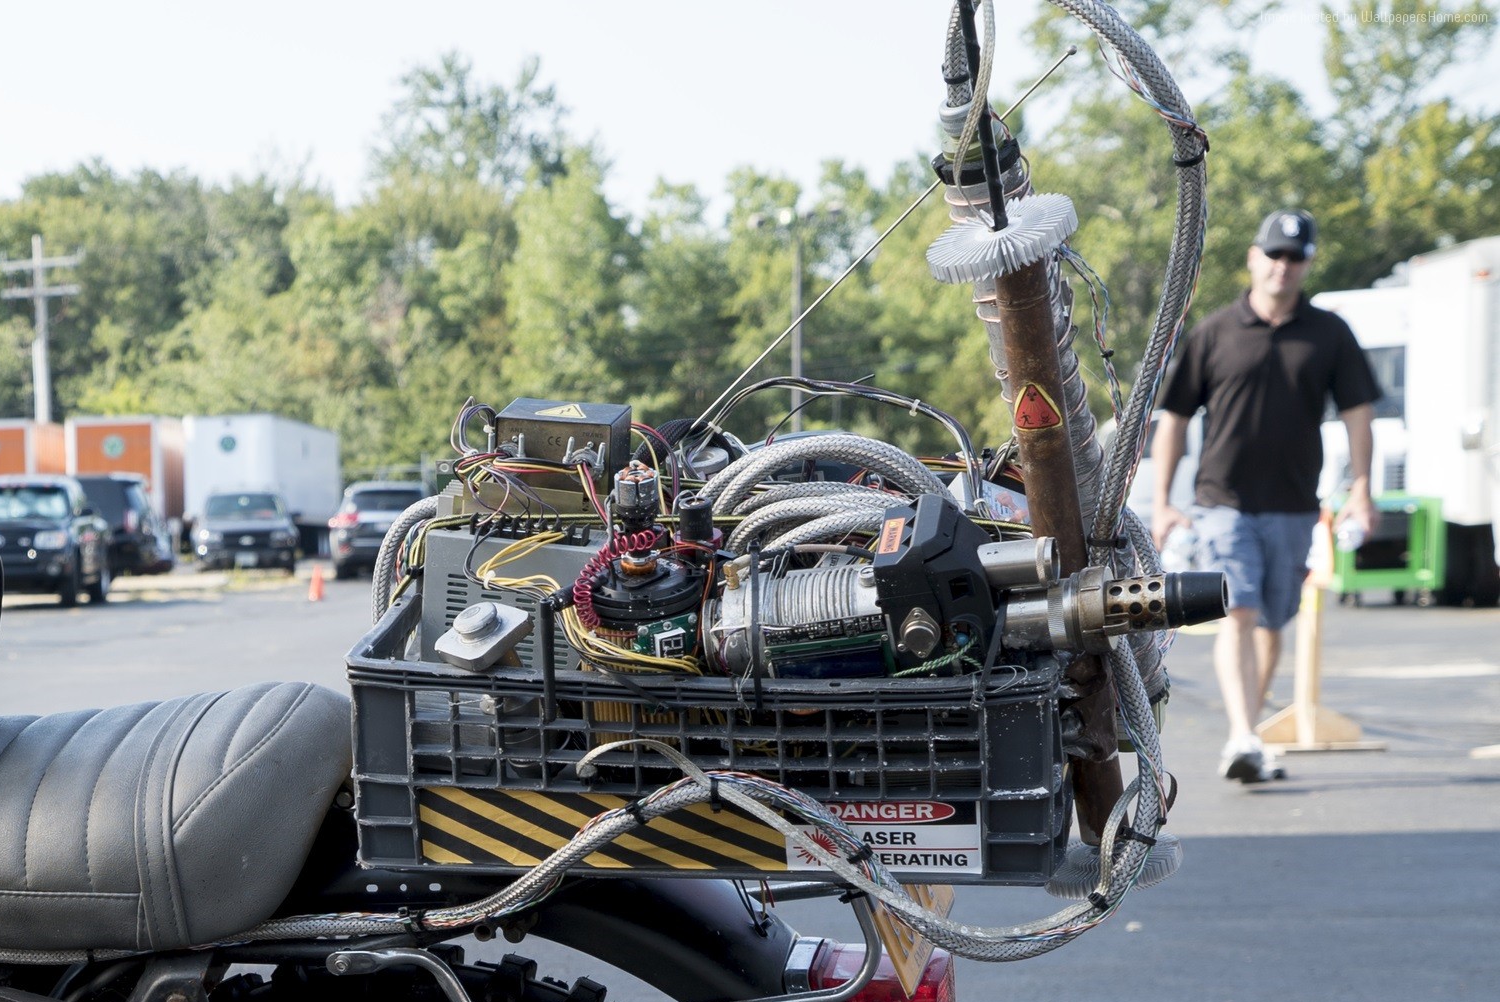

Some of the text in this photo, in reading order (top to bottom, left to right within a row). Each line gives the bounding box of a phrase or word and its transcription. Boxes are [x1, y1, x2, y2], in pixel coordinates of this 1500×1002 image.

[829, 803, 934, 819] DANGER
[862, 831, 917, 845] ASER
[875, 853, 969, 867] ERATING
